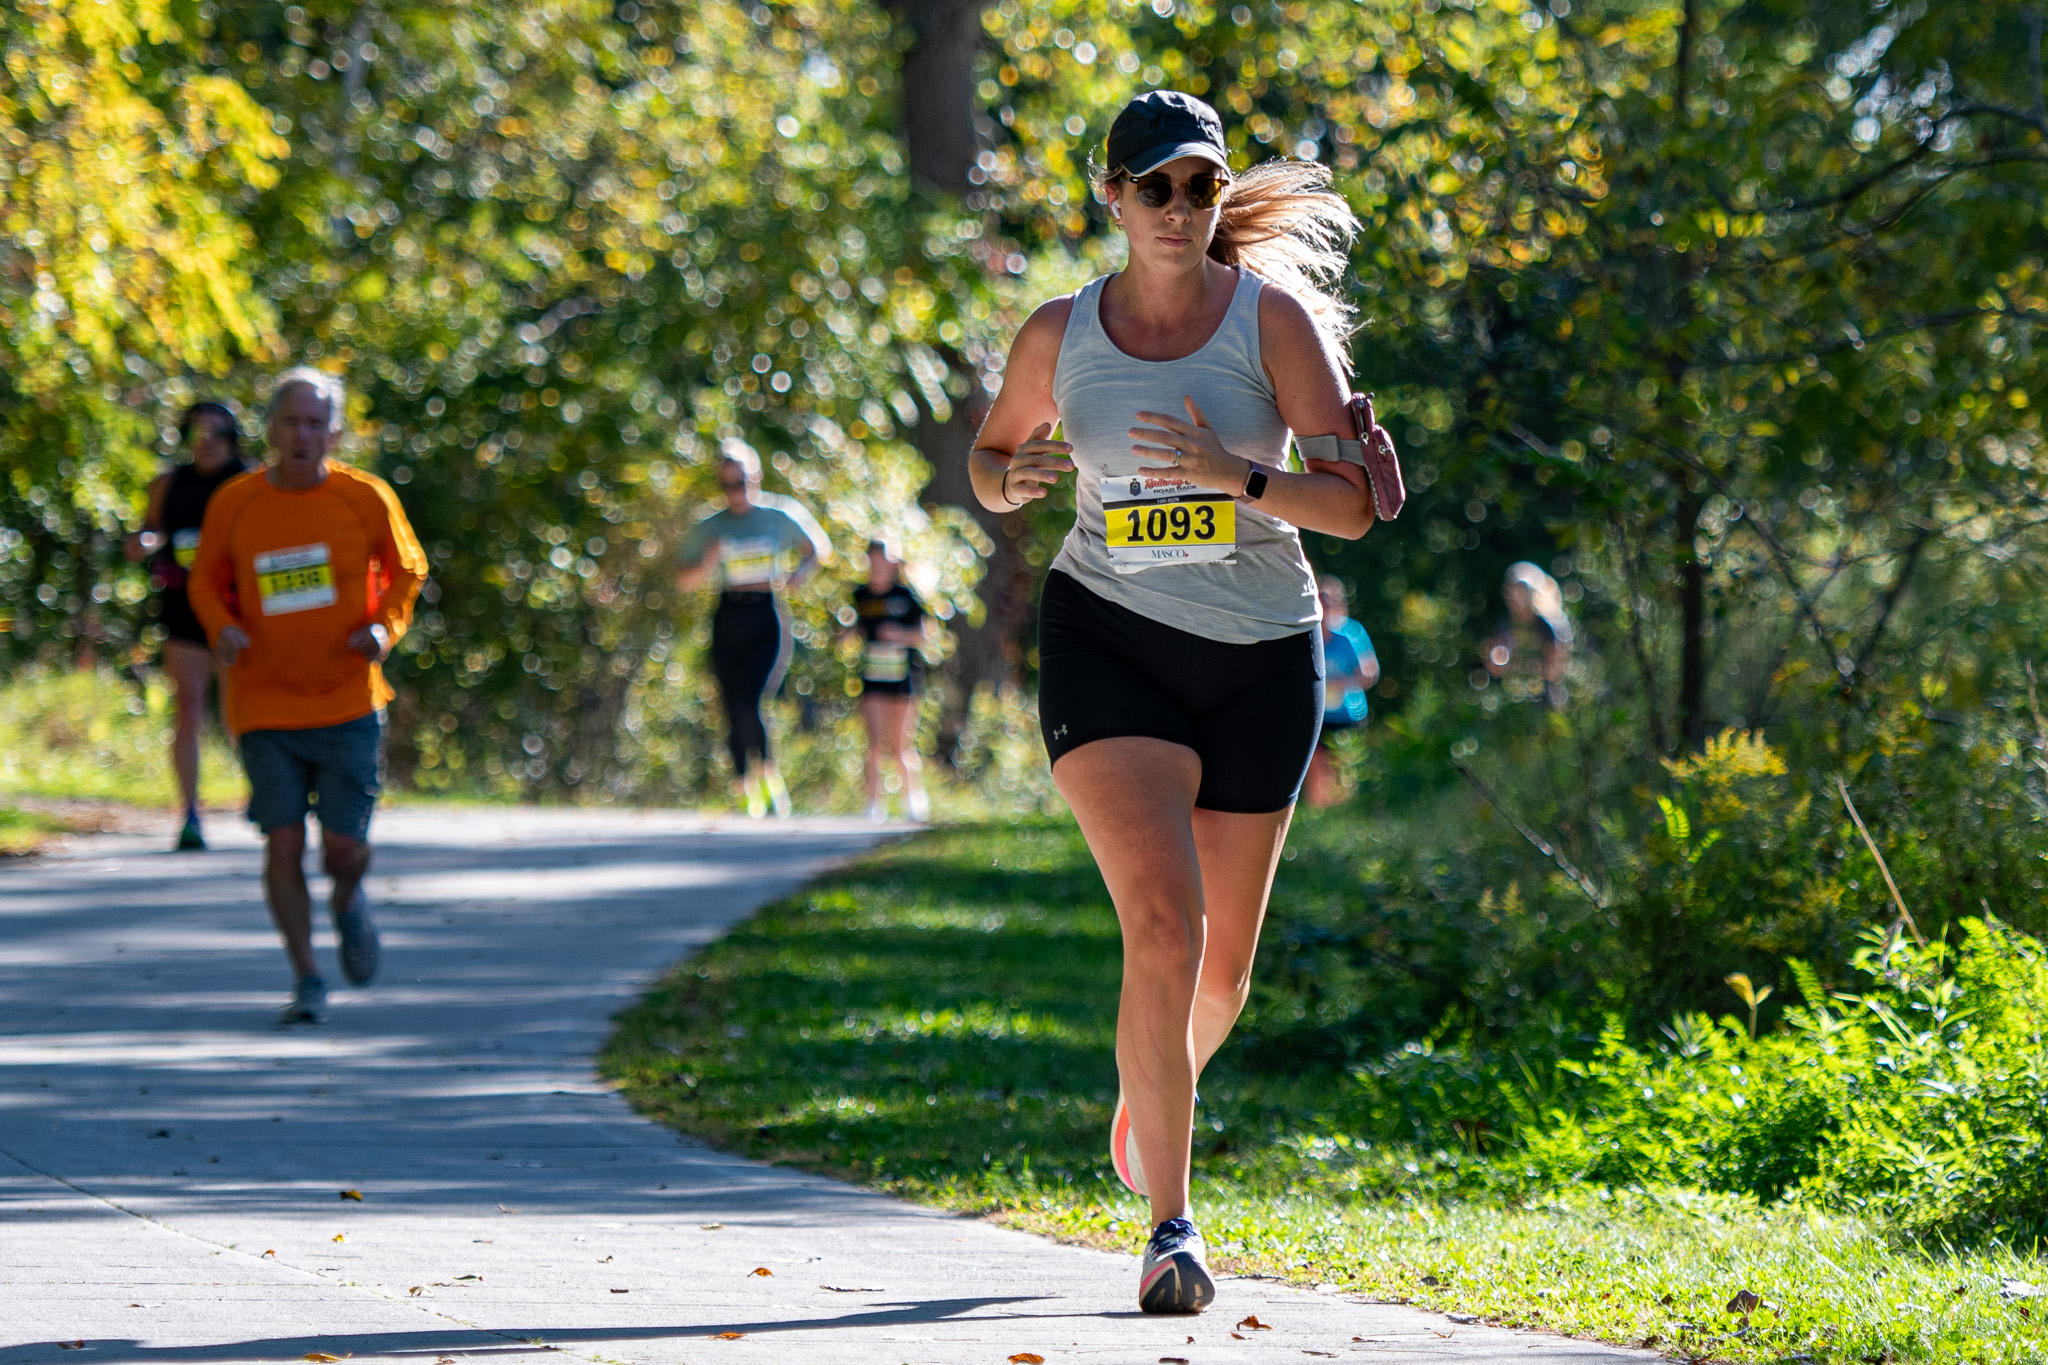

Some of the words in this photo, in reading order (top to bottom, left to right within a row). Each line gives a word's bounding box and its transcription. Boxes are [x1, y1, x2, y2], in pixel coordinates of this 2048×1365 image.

[1144, 478, 1183, 489] Railway
[1127, 505, 1216, 542] 1093
[1151, 549, 1186, 559] MASCO
